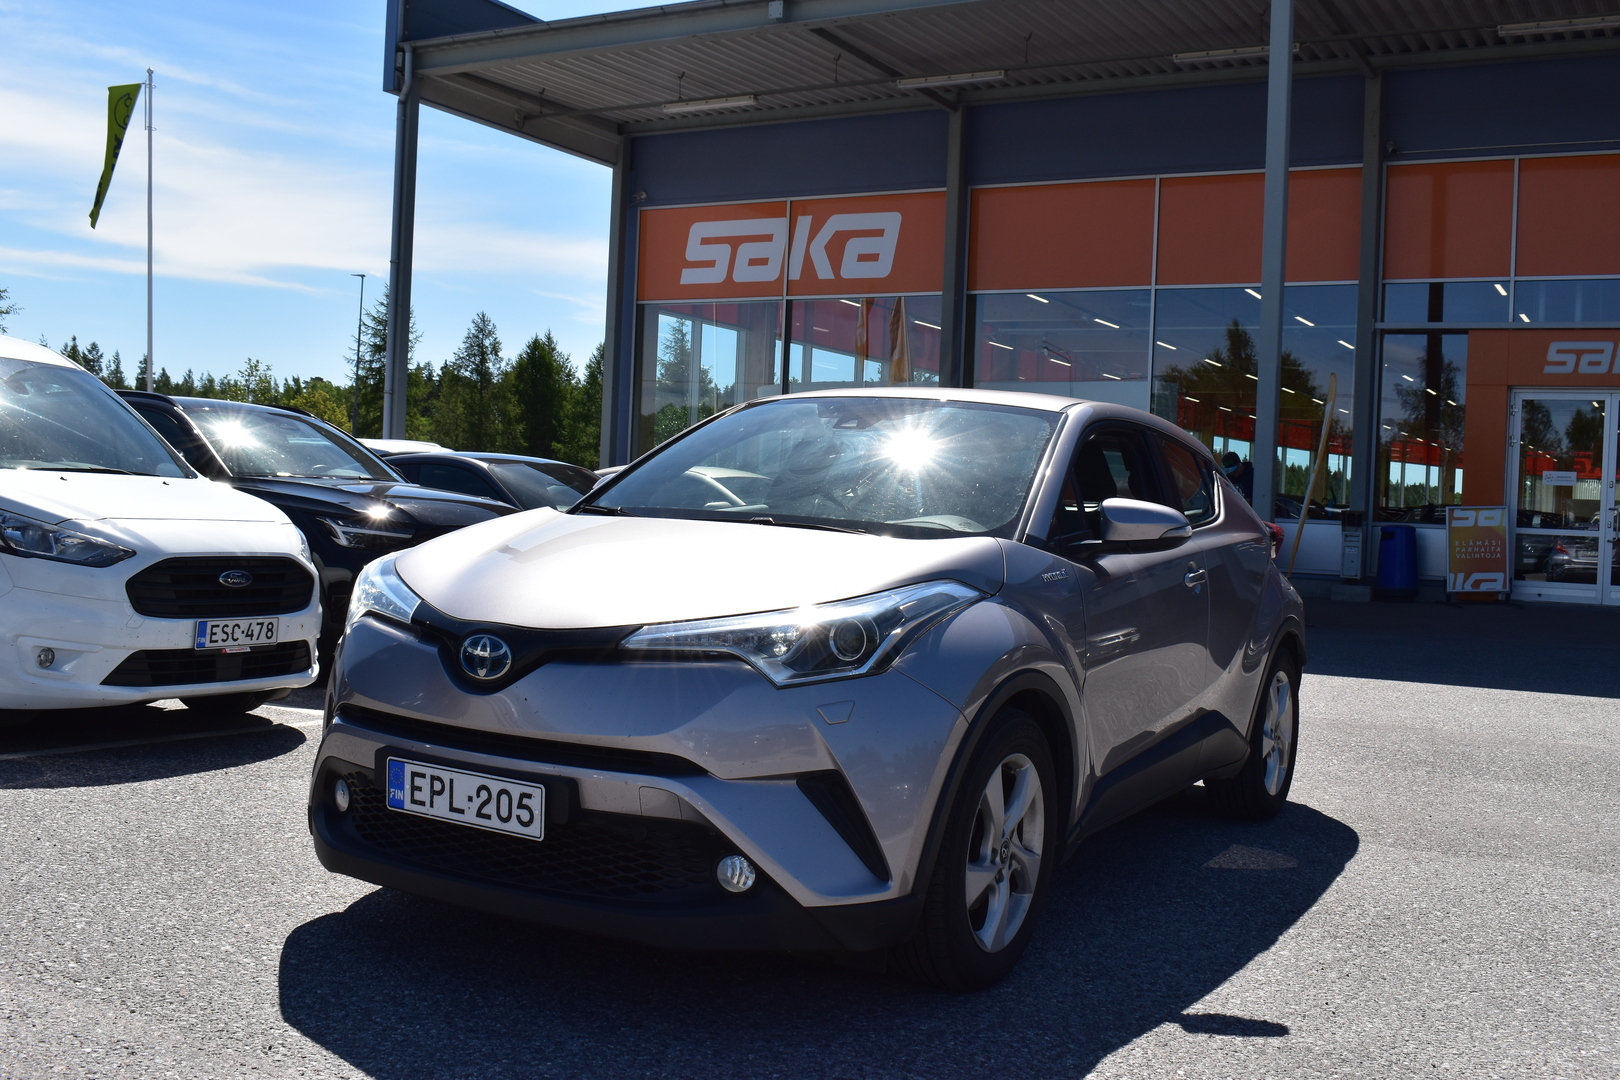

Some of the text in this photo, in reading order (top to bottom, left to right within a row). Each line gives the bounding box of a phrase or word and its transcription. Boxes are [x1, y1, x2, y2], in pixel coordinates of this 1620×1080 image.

[1543, 341, 1620, 374] sa
[209, 622, 275, 644] ESC-478
[389, 771, 535, 828] FIN EPL-205
